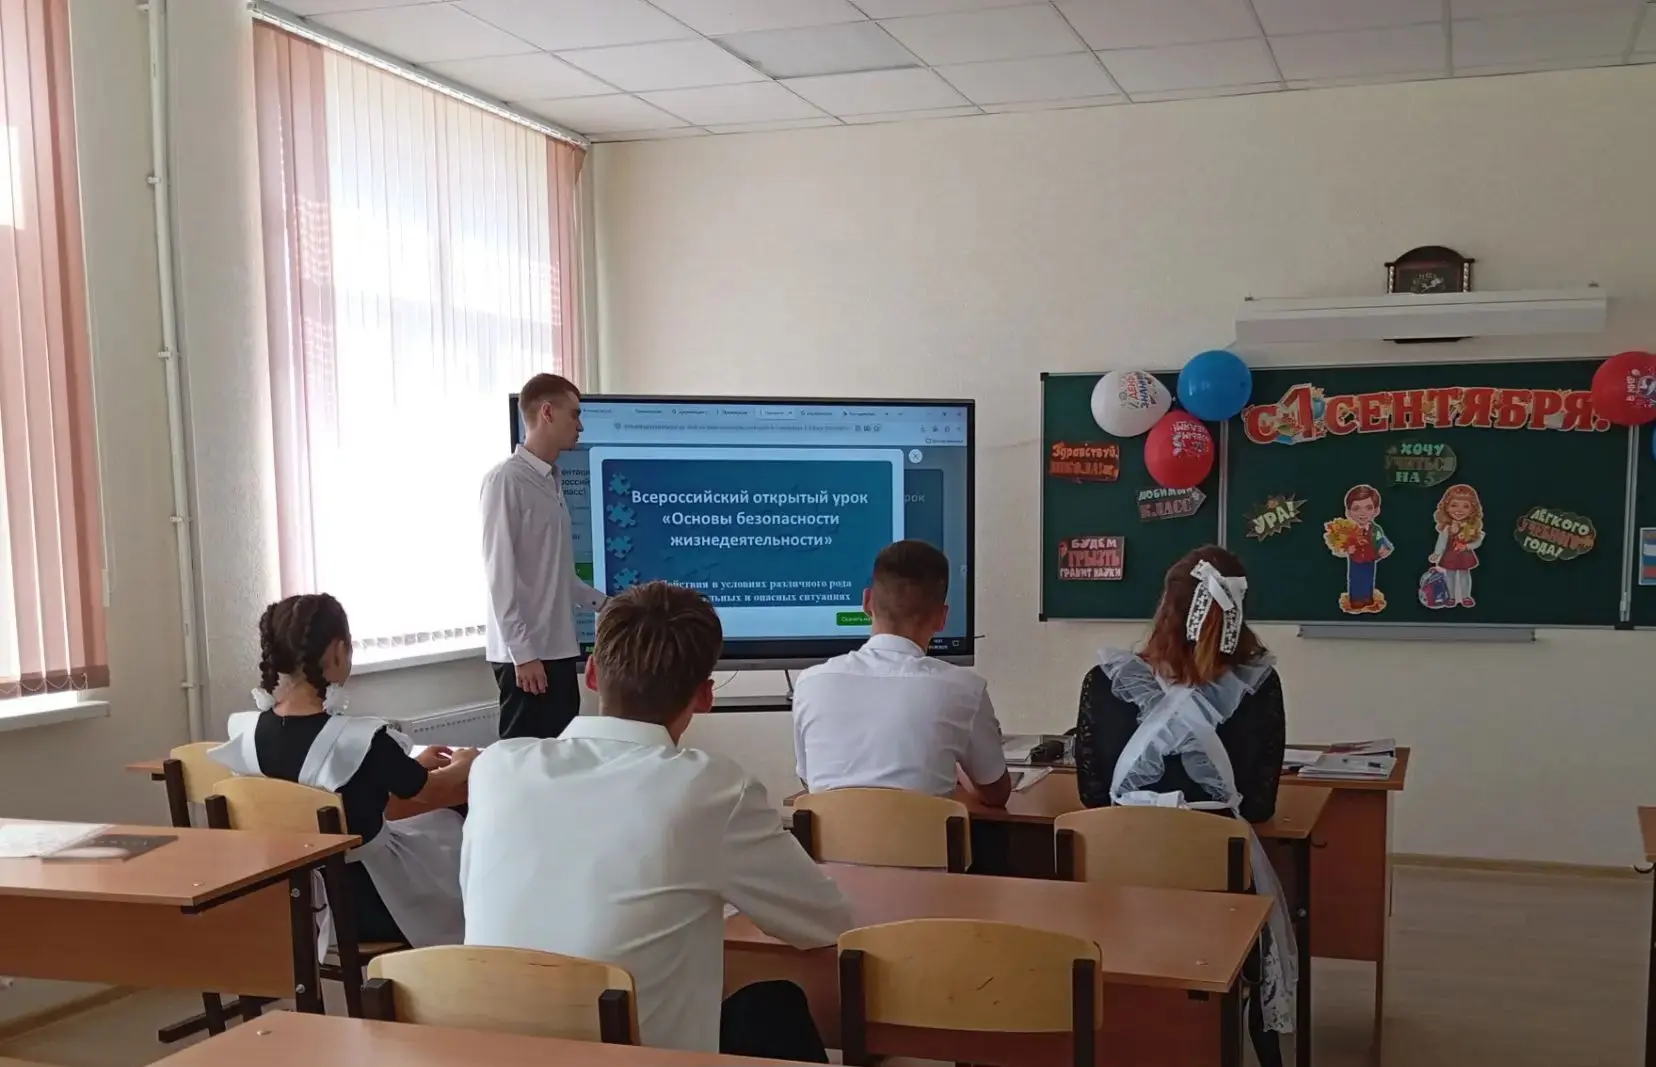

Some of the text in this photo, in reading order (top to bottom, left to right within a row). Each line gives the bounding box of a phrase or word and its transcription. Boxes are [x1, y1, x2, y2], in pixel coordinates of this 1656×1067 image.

[1243, 404, 1279, 444] С
[1279, 383, 1315, 441] 1
[1401, 443, 1445, 456] ХОЧУ
[1396, 471, 1420, 483] НА
[631, 490, 868, 507] Всероссийский открытый урок
[1140, 498, 1192, 518] КЛАСС
[662, 512, 840, 525] «Основы безопасности
[1252, 501, 1295, 534] УРА!
[670, 534, 833, 549] жизнедеятельности»
[1071, 538, 1117, 549] БУДЕМ
[1523, 536, 1563, 557] ГОДА!
[1060, 567, 1121, 578] ГРАНИТ НАУКИ
[721, 581, 767, 591] условиях
[769, 580, 827, 590] различного
[829, 581, 852, 590] рода
[799, 595, 850, 603] ситуациях
